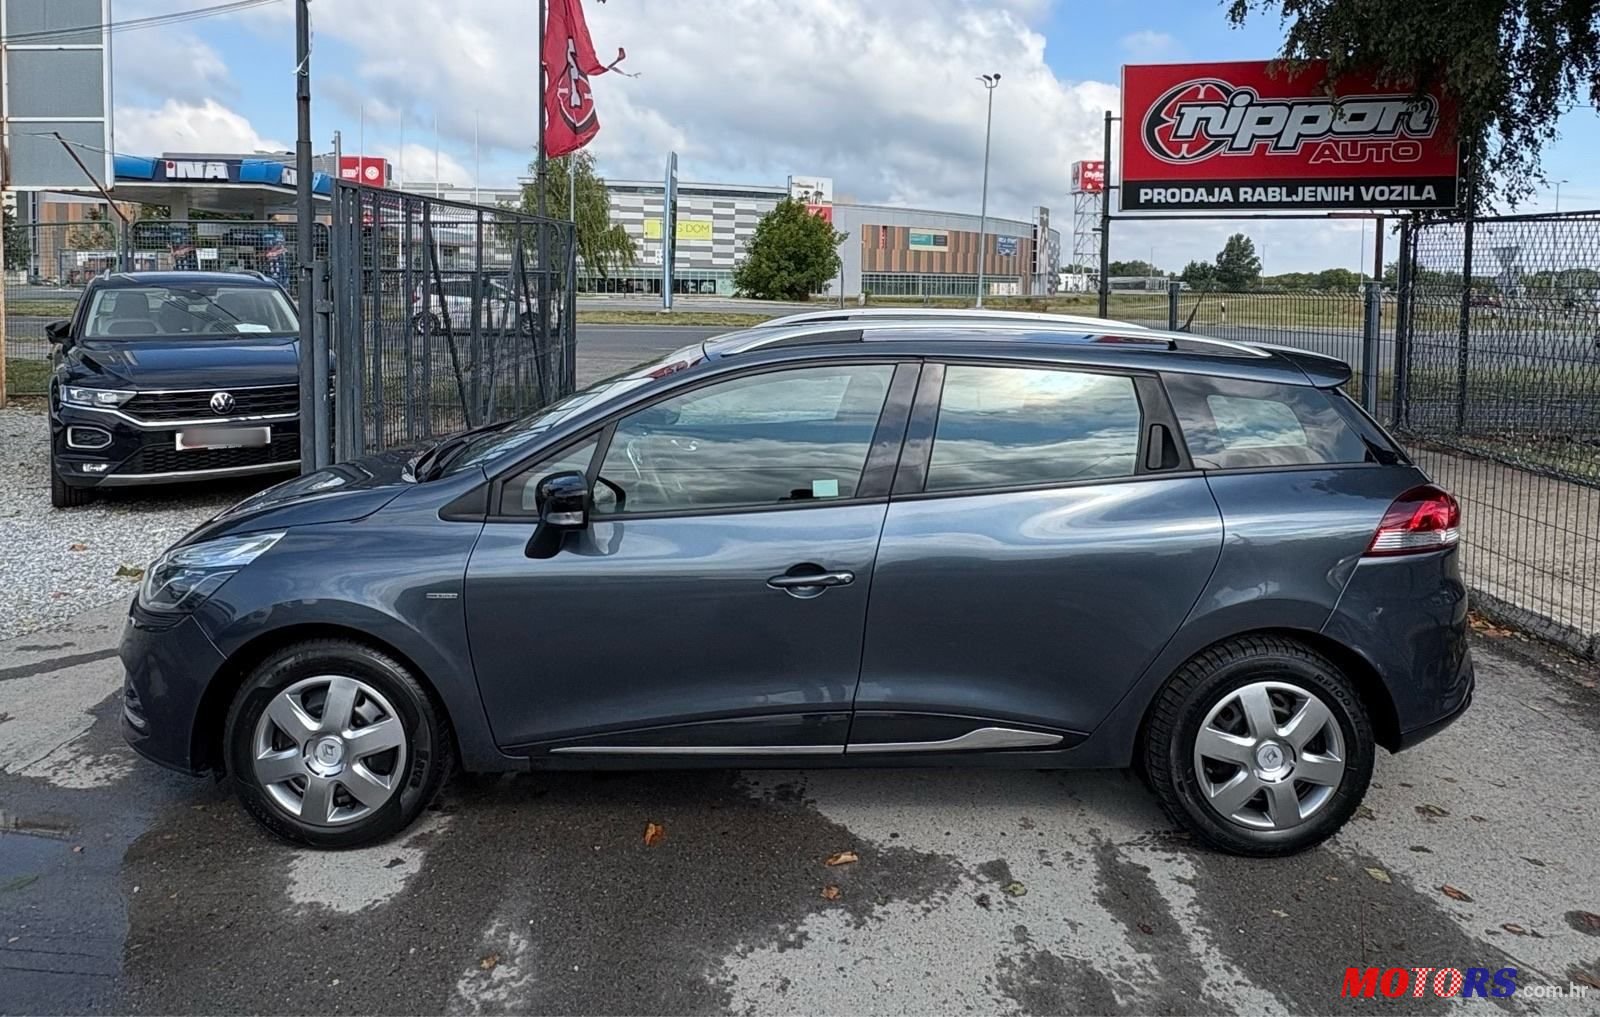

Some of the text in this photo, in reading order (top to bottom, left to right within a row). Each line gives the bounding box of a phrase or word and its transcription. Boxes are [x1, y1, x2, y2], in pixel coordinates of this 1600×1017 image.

[1174, 92, 1437, 151] nippon
[1309, 141, 1422, 164] AUTO
[1139, 184, 1437, 204] PRODAJA RABLJENIH VOZILA
[685, 223, 710, 233] DOM
